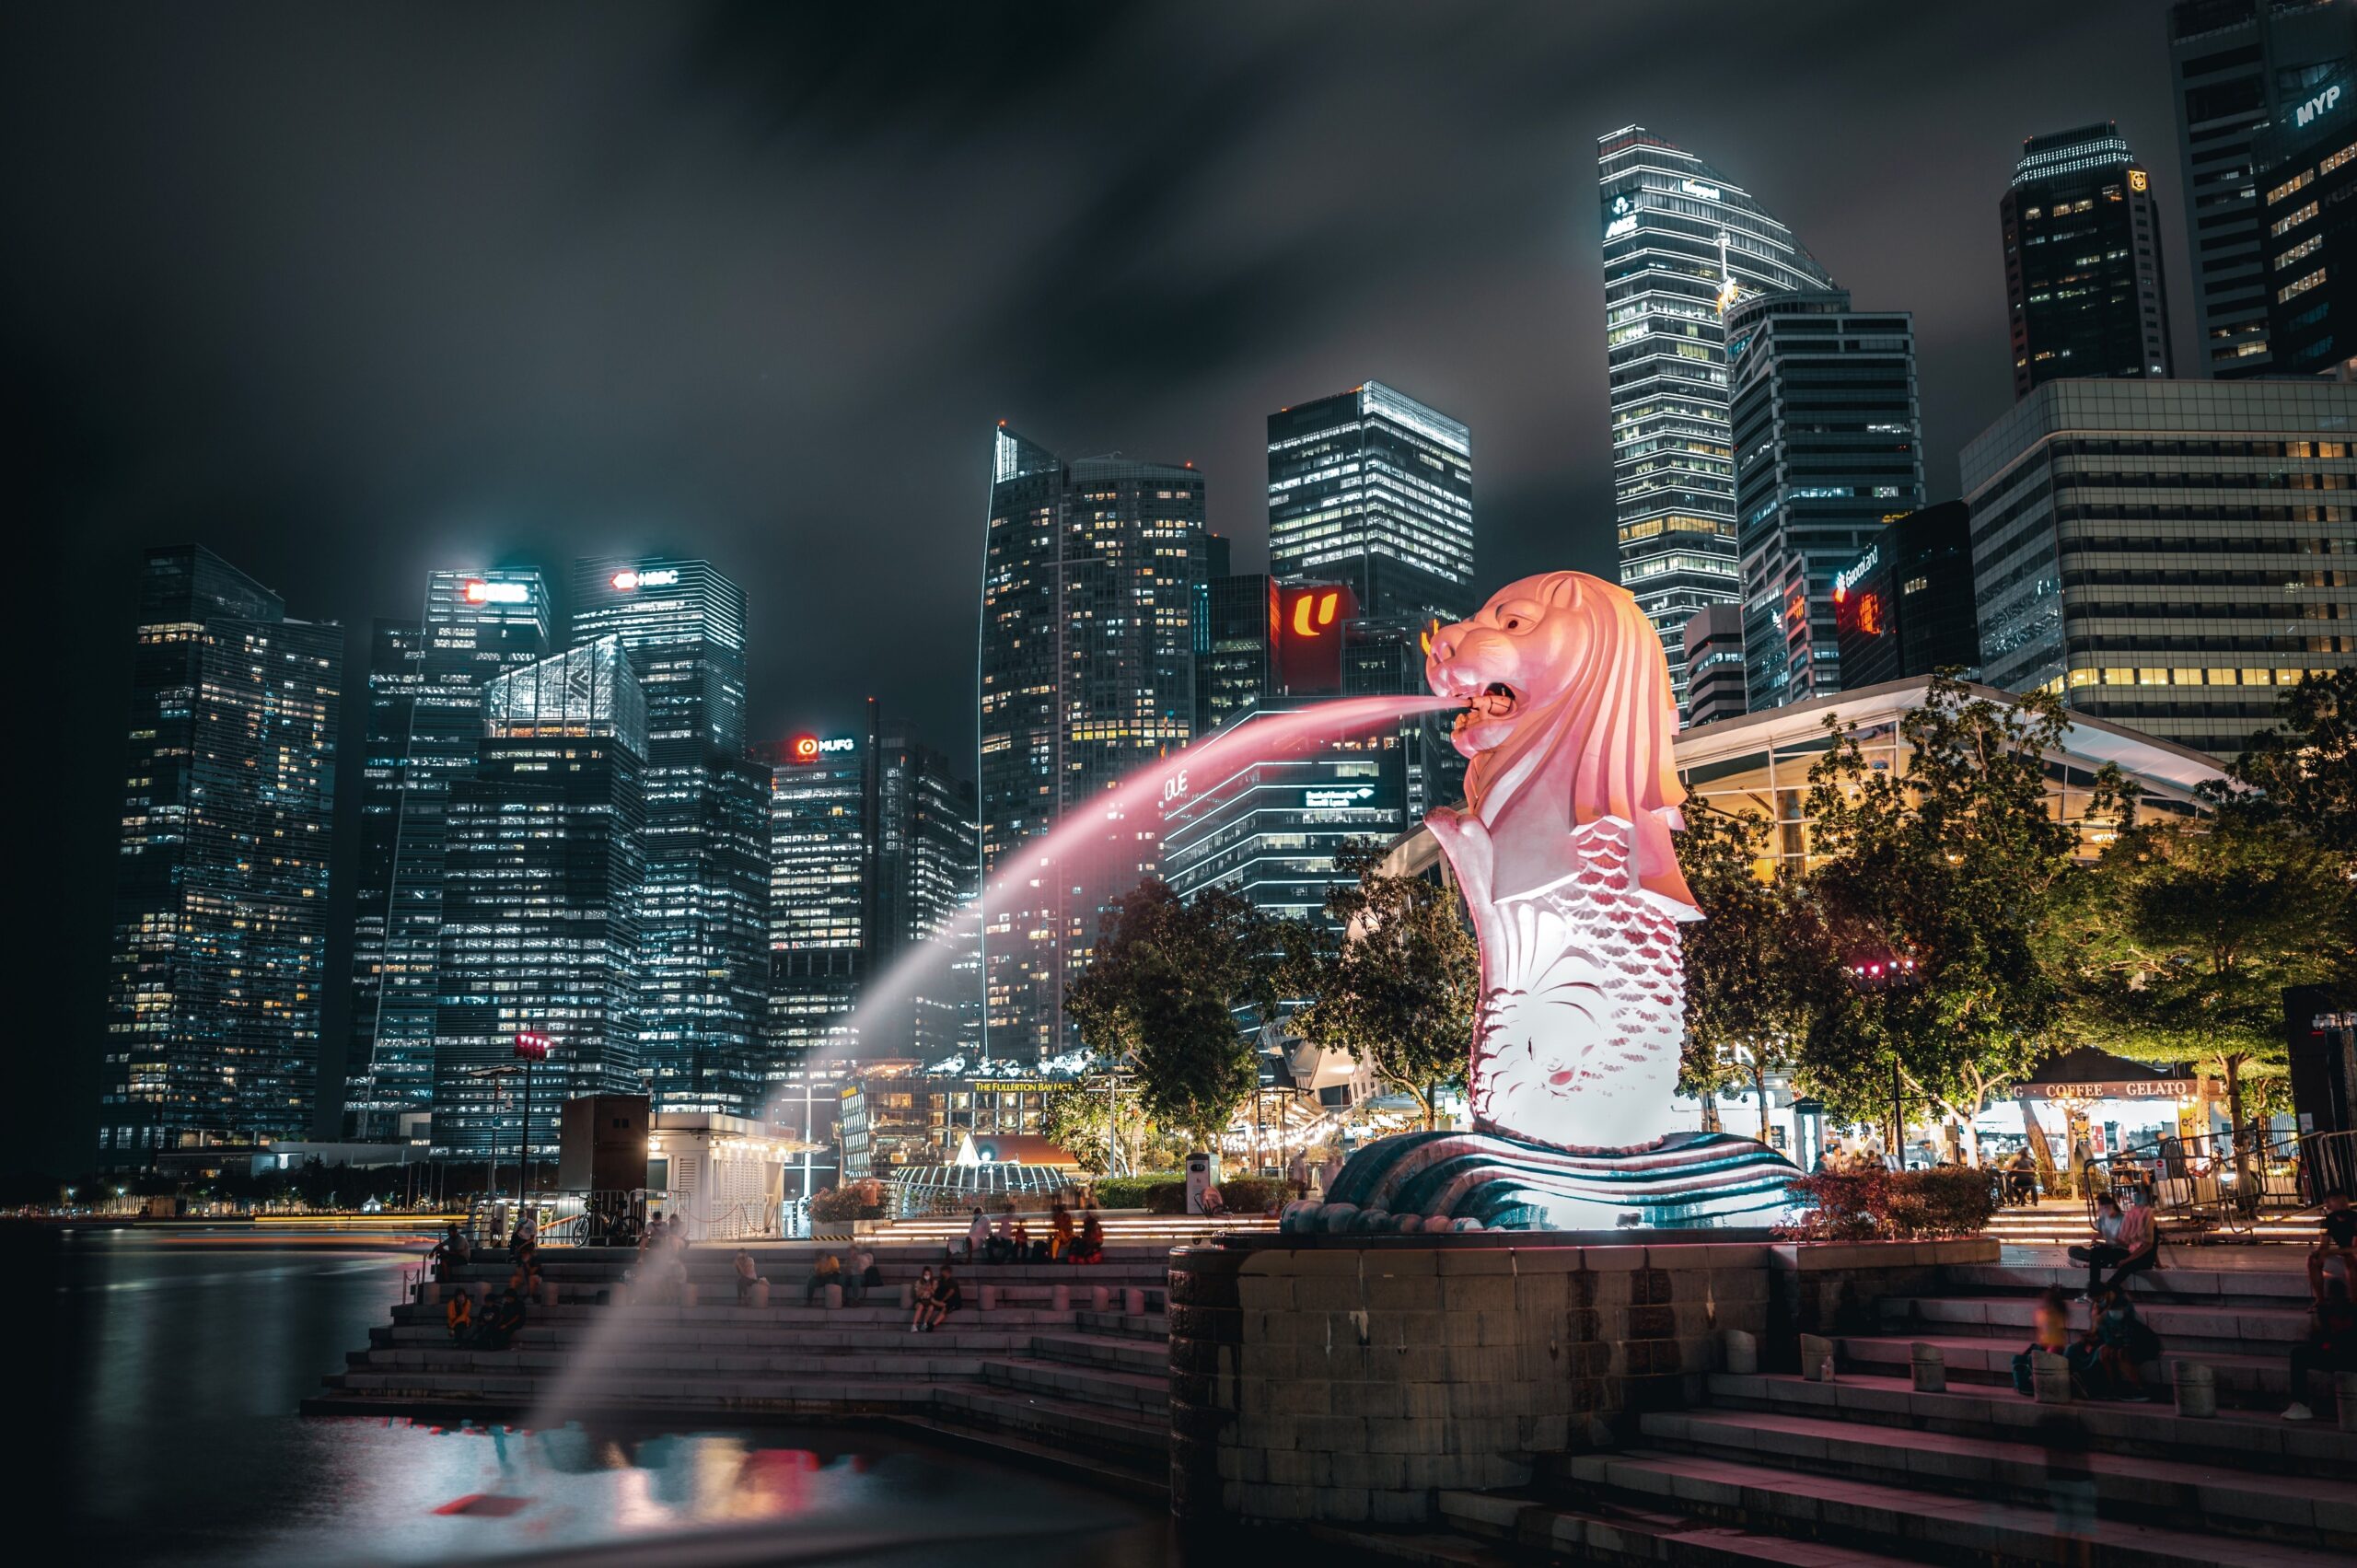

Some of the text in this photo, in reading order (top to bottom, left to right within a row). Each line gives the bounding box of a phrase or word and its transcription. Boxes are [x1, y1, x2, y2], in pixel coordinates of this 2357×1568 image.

[2296, 86, 2340, 127] MYP
[819, 738, 854, 752] MUFG
[1165, 769, 1188, 802] OUE
[976, 1083, 991, 1091] THE
[993, 1083, 1037, 1092] FULLERTON
[1038, 1083, 1053, 1091] BAY
[2046, 1081, 2187, 1098] COFFEE GELATO
